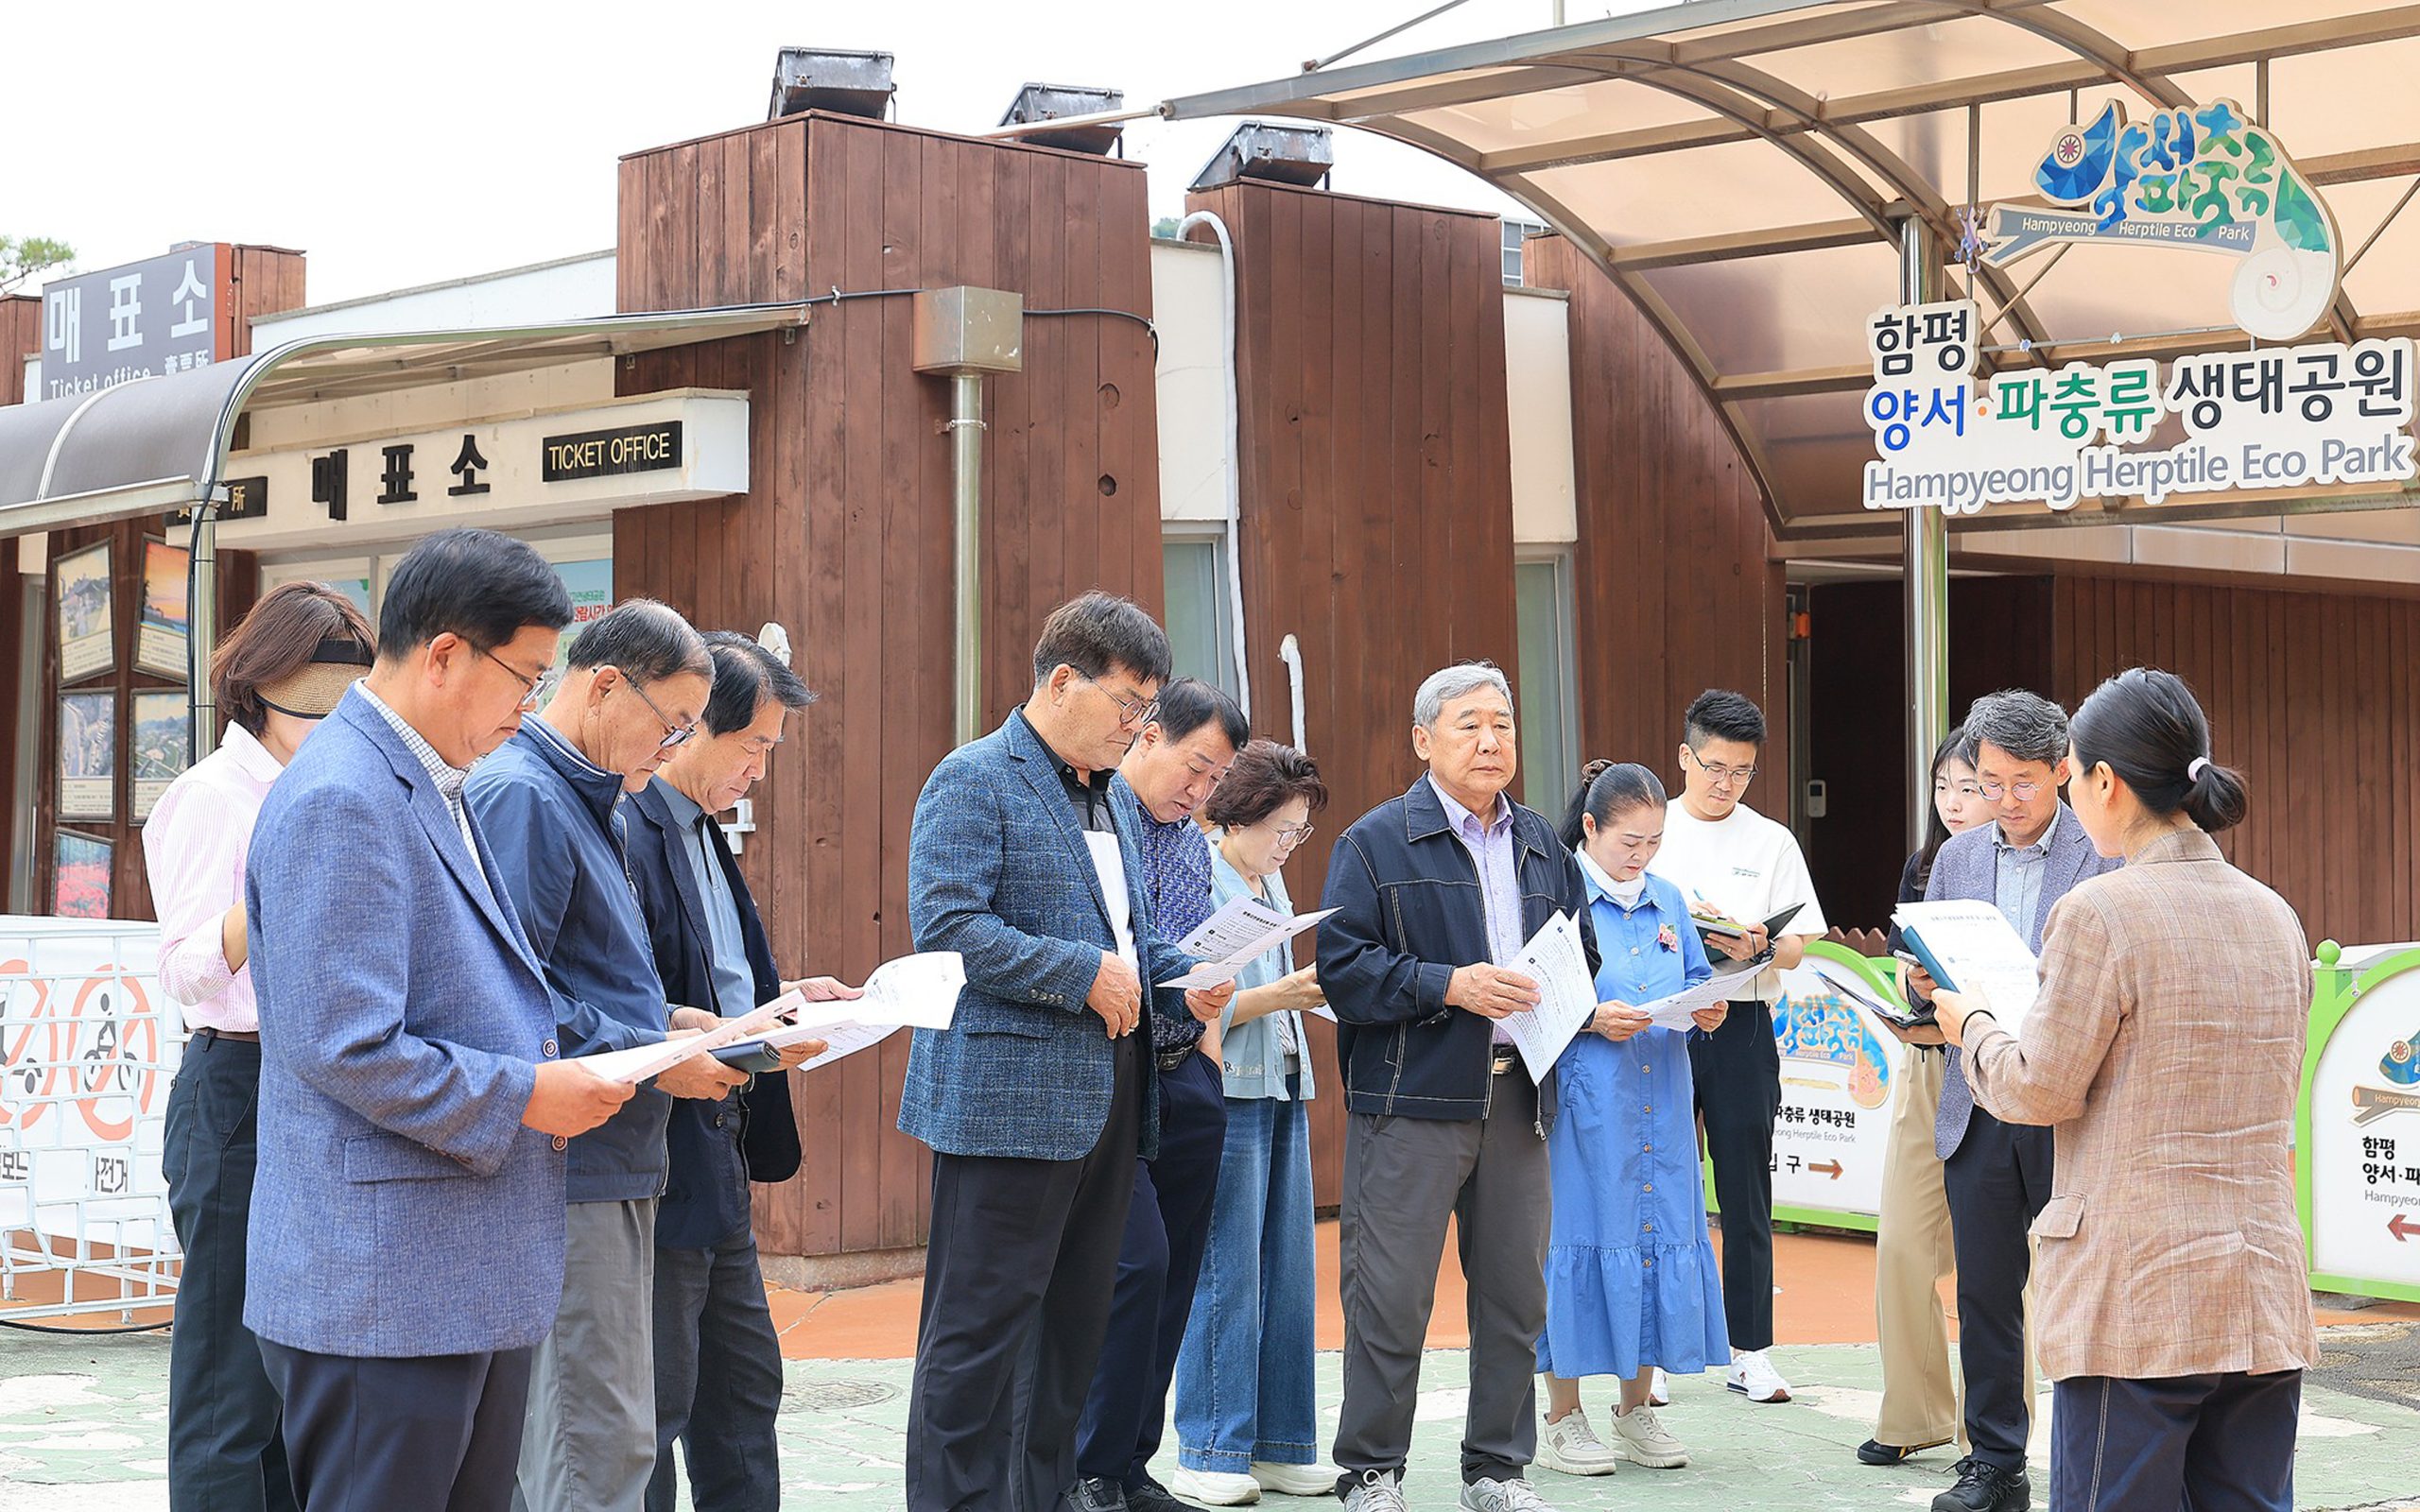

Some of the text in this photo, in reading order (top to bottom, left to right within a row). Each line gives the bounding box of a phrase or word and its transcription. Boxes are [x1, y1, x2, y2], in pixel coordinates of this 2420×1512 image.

[2021, 216, 2251, 241] Hampyeong Herptile Eco Park
[1874, 308, 1968, 375] 함평
[50, 373, 98, 400] Ticket
[2172, 348, 2404, 430] 생태공원
[548, 432, 670, 471] TICKET OFFICE
[1869, 433, 2407, 508] Hampyeong Herptile Eco Park
[2375, 1093, 2420, 1108] Hampyeon
[1808, 1108, 1855, 1128] 생태공원
[1824, 1131, 1838, 1143] Eco
[1839, 1132, 1857, 1143] Park
[2362, 1135, 2395, 1160] 함평
